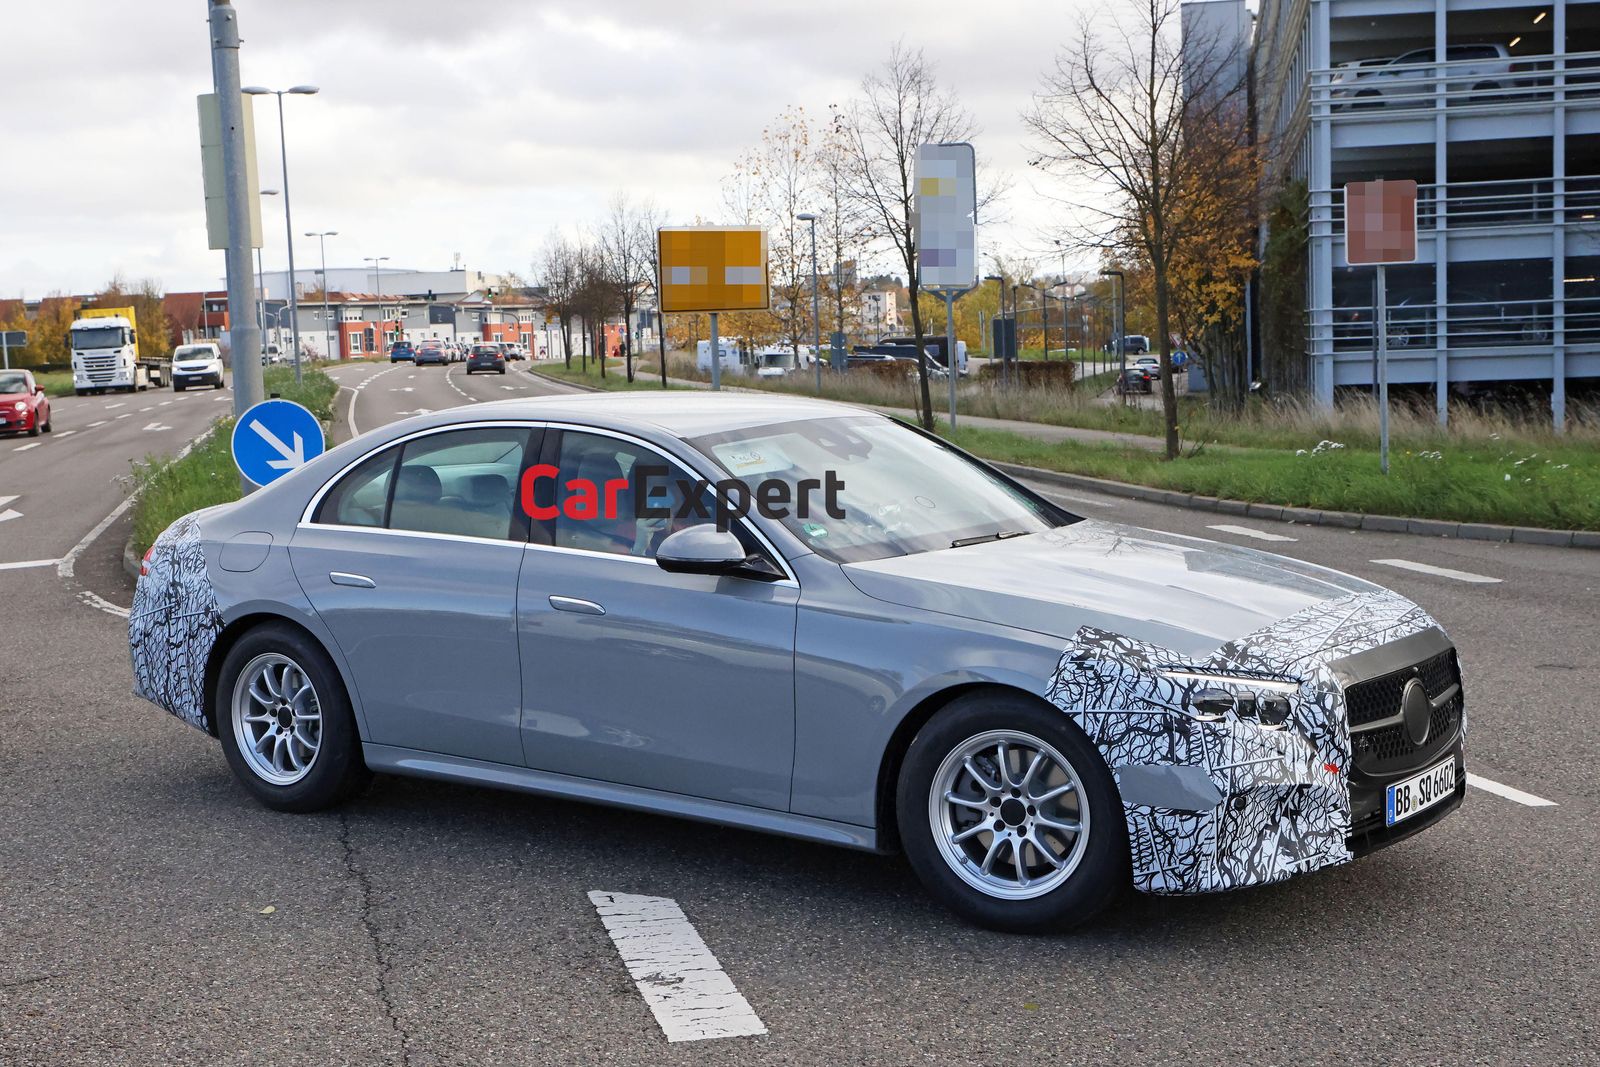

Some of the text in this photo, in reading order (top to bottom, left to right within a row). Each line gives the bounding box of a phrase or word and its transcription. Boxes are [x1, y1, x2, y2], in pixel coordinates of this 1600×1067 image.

[1396, 762, 1454, 816] BB SQ 6602
